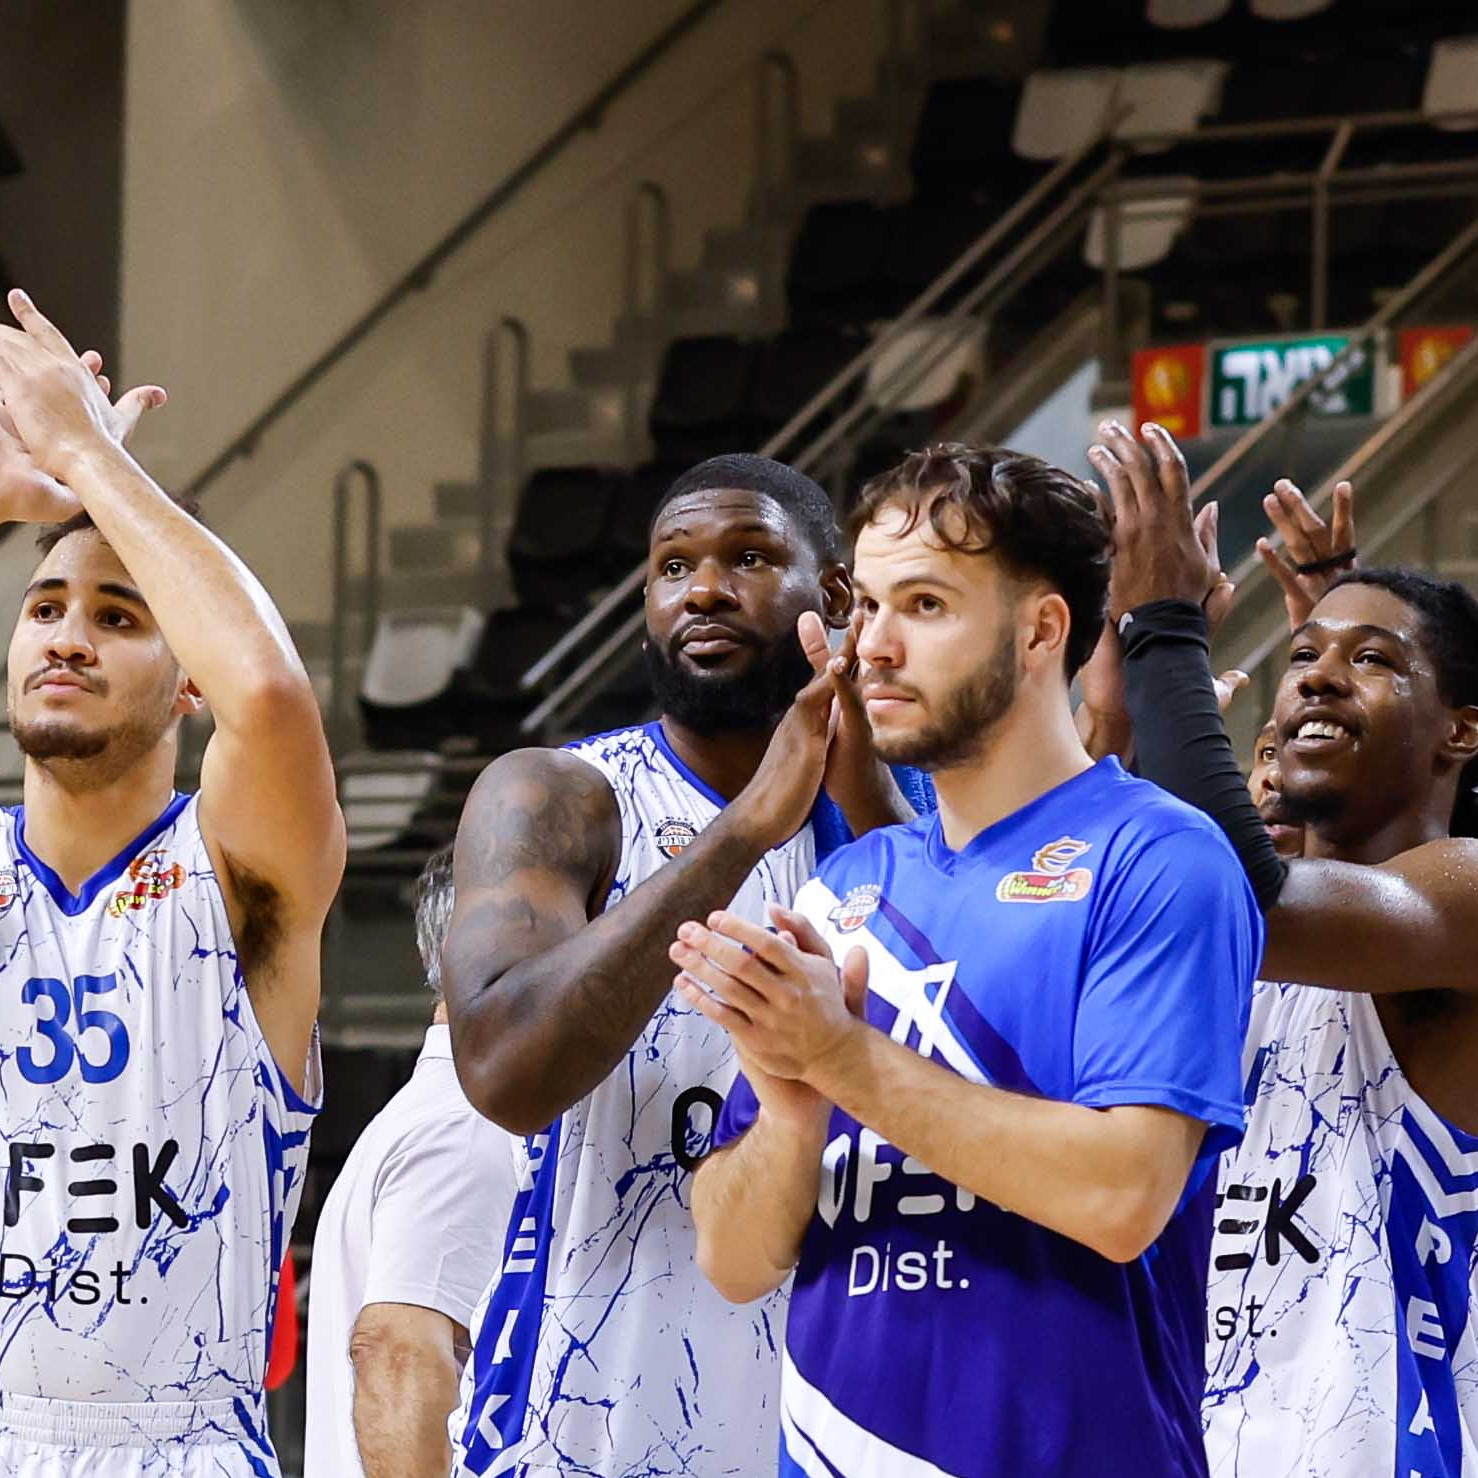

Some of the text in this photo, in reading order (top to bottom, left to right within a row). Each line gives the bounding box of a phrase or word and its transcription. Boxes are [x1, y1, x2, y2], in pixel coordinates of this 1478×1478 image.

[16, 975, 129, 1084] 35
[818, 1128, 1014, 1229] OFE
[1215, 1173, 1320, 1271] EK
[848, 1240, 970, 1297] Dist.
[1206, 1294, 1278, 1342] st.
